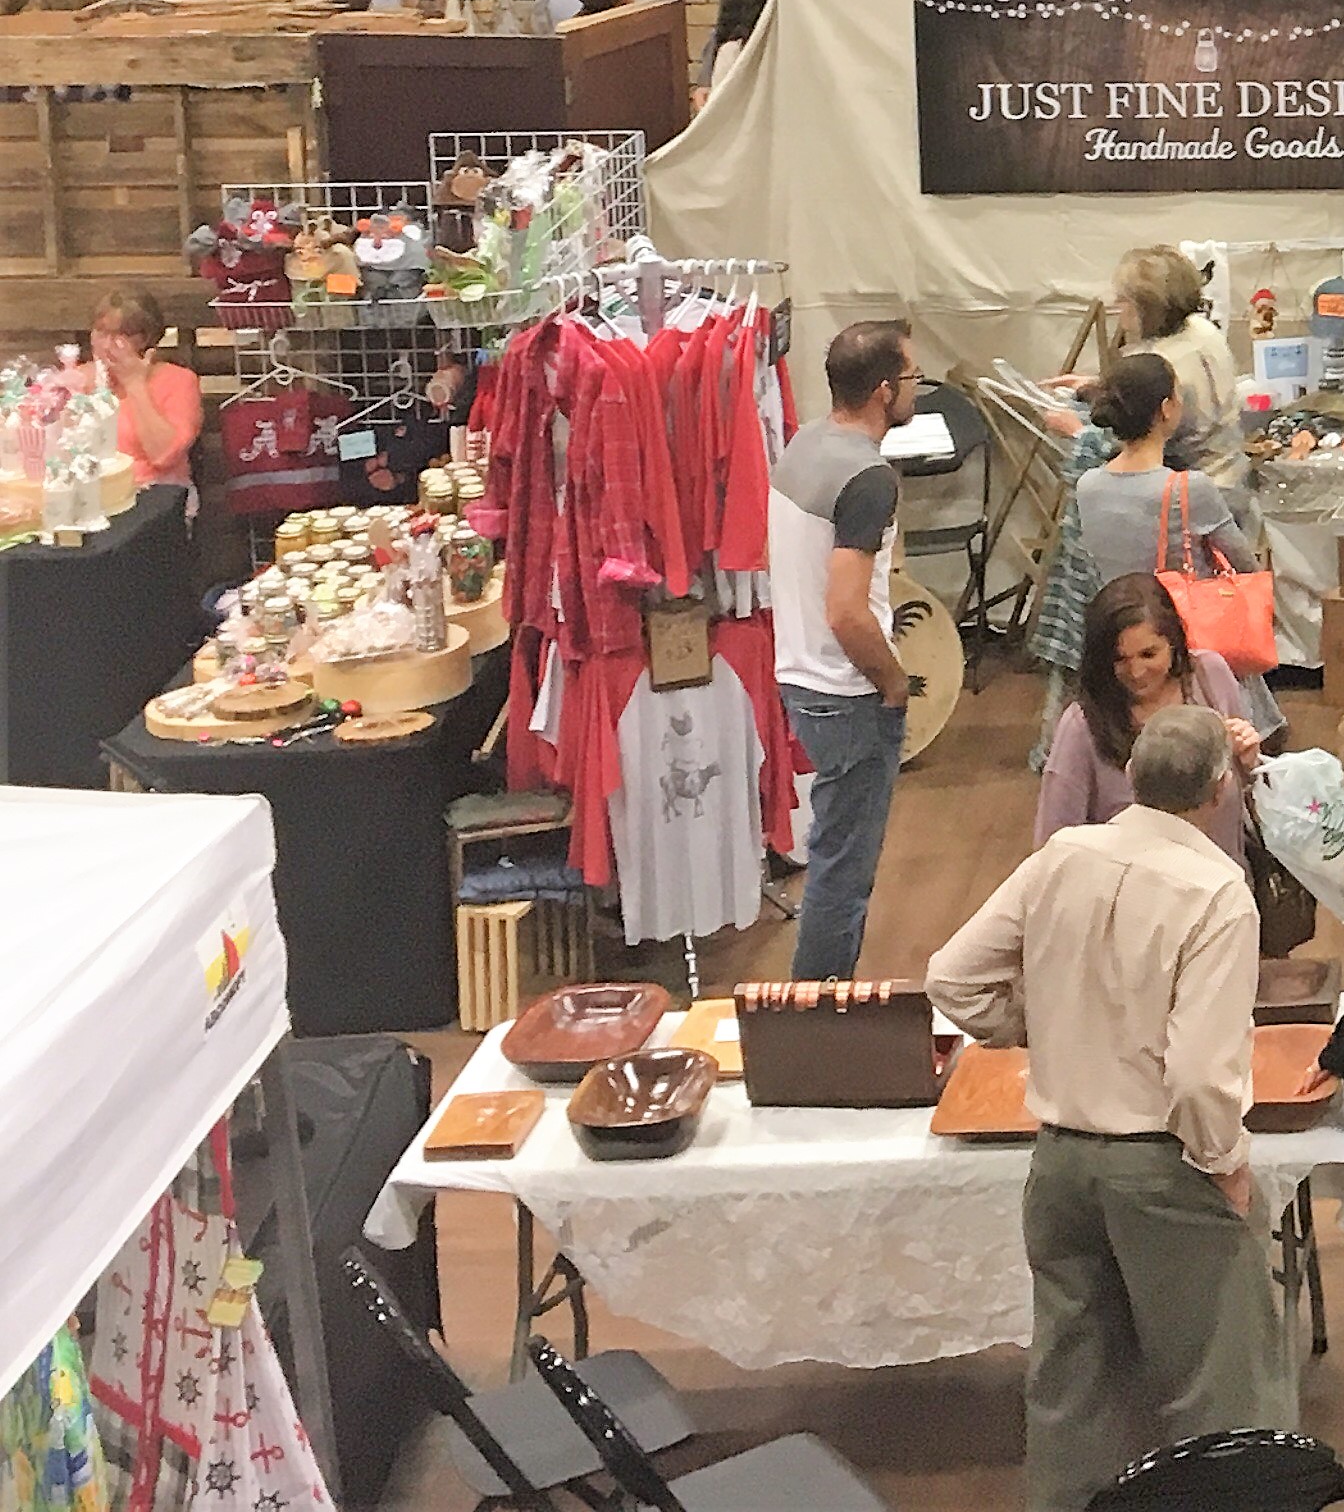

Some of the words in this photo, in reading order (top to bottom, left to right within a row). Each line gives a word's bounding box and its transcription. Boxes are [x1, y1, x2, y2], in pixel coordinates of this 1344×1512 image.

[967, 82, 1093, 122] JUST
[1106, 81, 1223, 120] FINE
[1084, 126, 1237, 162] Handmade
